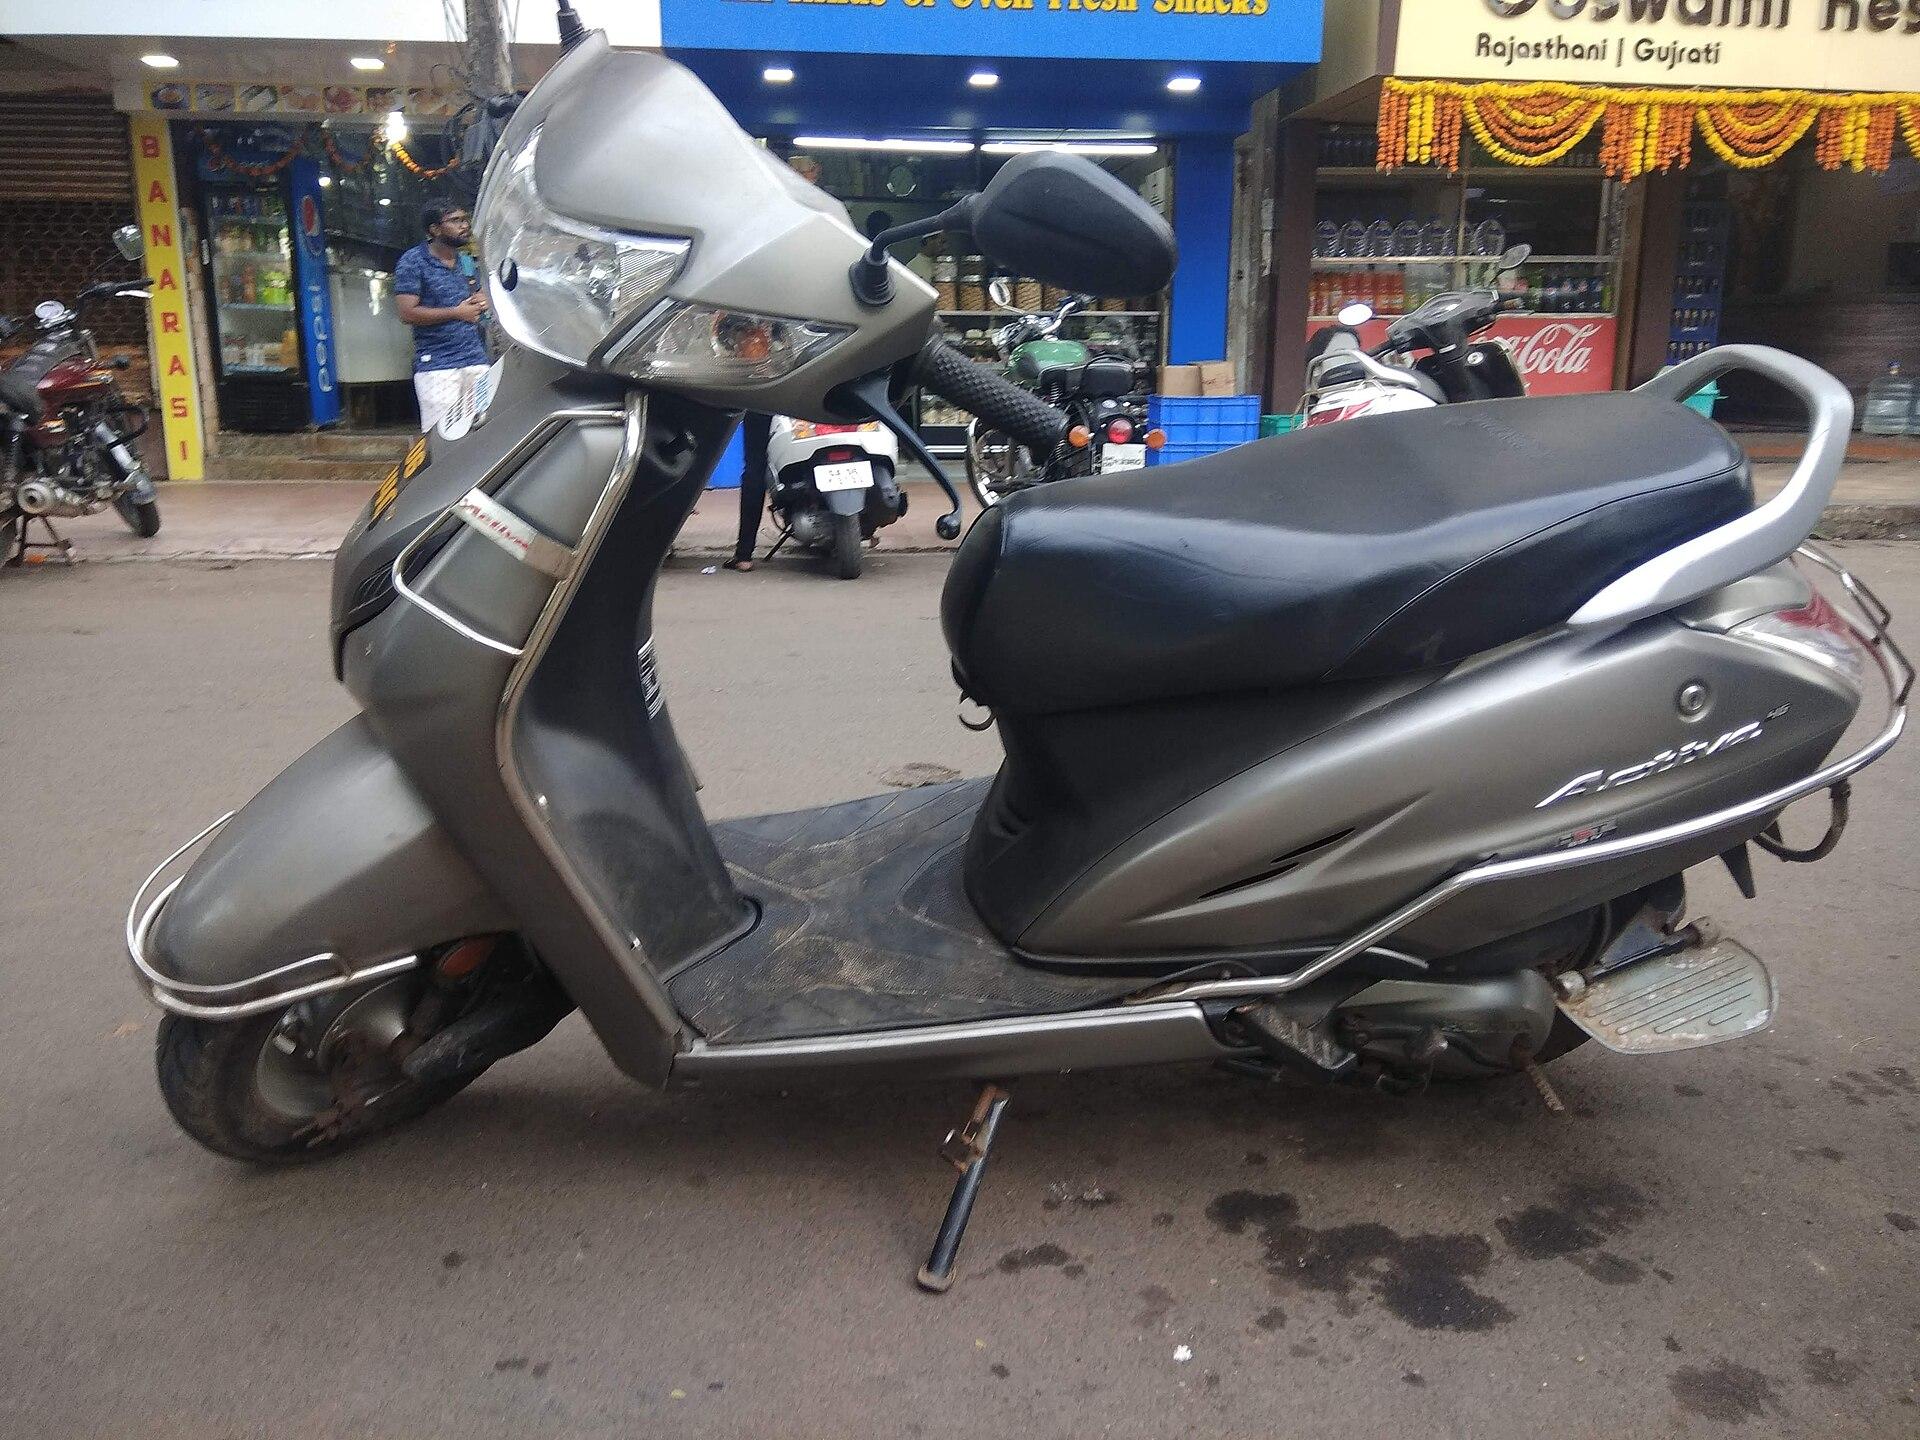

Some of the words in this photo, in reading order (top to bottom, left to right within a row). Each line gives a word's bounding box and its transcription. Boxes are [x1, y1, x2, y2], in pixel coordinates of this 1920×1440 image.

[1476, 33, 1608, 66] Rajasthani
[1634, 38, 1721, 70] Gujrati
[140, 134, 191, 461] BANARASI
